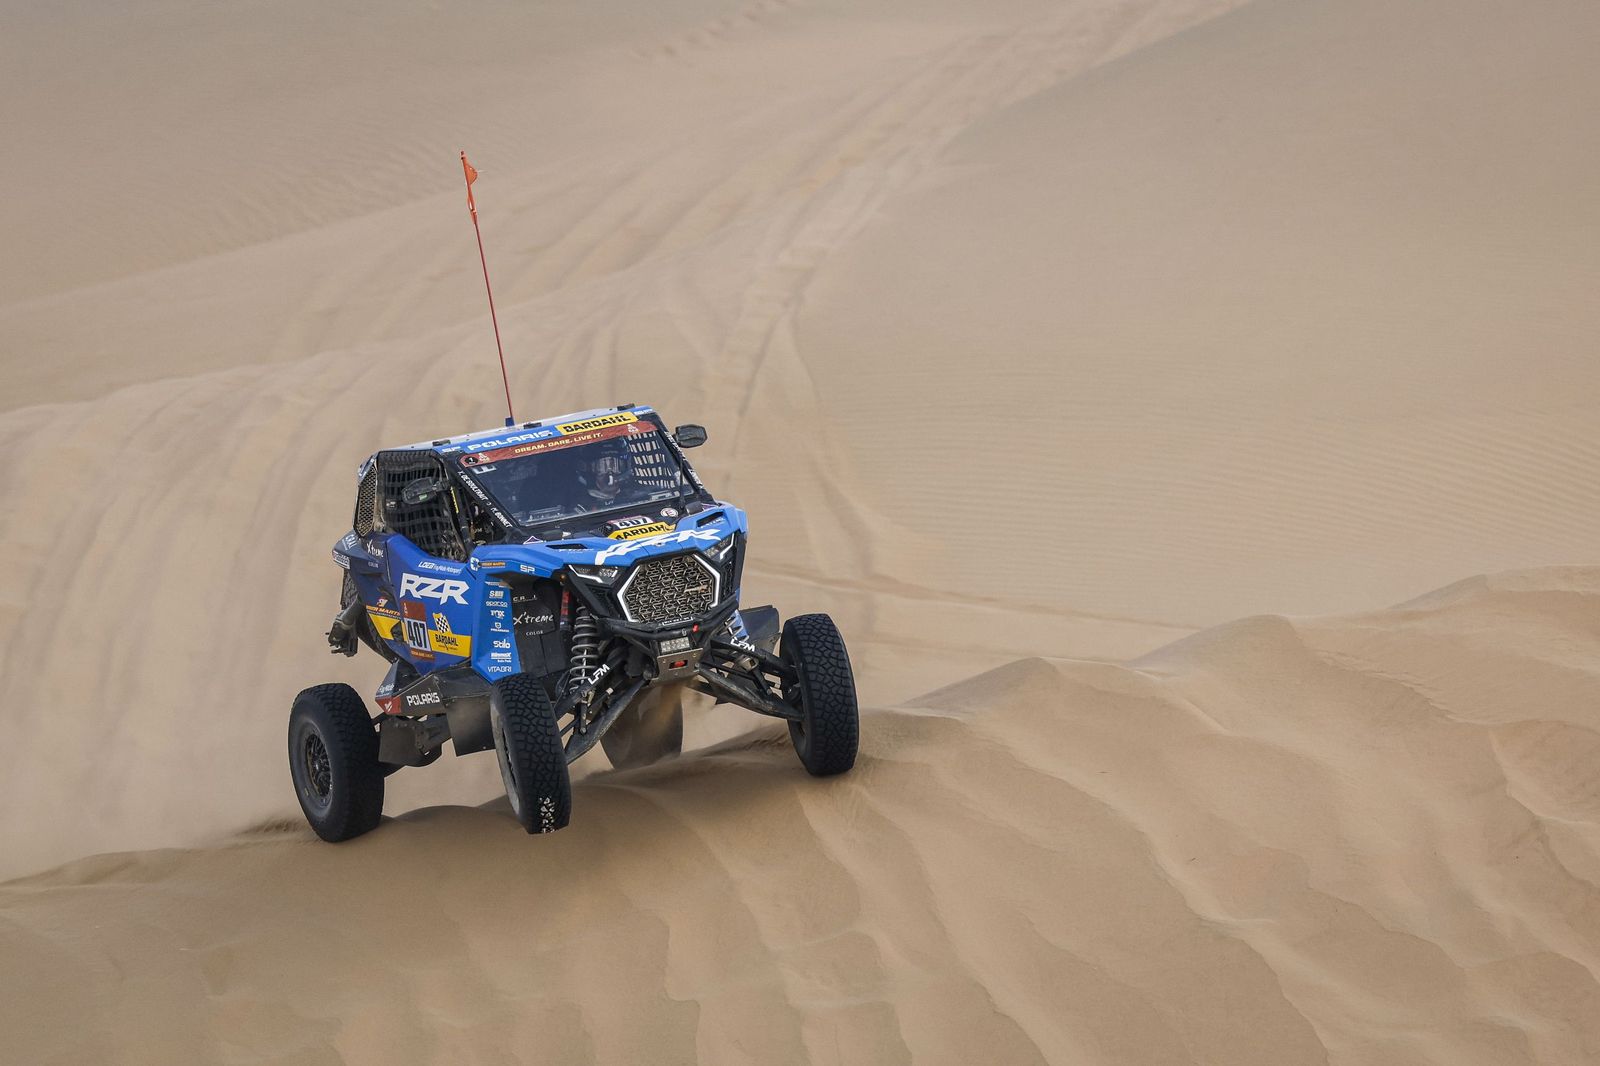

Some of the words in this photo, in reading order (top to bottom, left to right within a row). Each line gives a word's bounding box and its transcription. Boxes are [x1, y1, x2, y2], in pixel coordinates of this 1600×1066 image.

[563, 415, 631, 433] BARDAHL
[467, 429, 554, 451] POLARIS
[514, 444, 548, 455] DREAM.
[548, 439, 573, 448] DARE.
[574, 434, 592, 443] LIVE
[399, 572, 470, 605] RZR
[407, 621, 428, 648] 407
[435, 633, 459, 647] BARDAHL
[492, 638, 511, 649] Stilo
[405, 692, 441, 707] POLARIS
